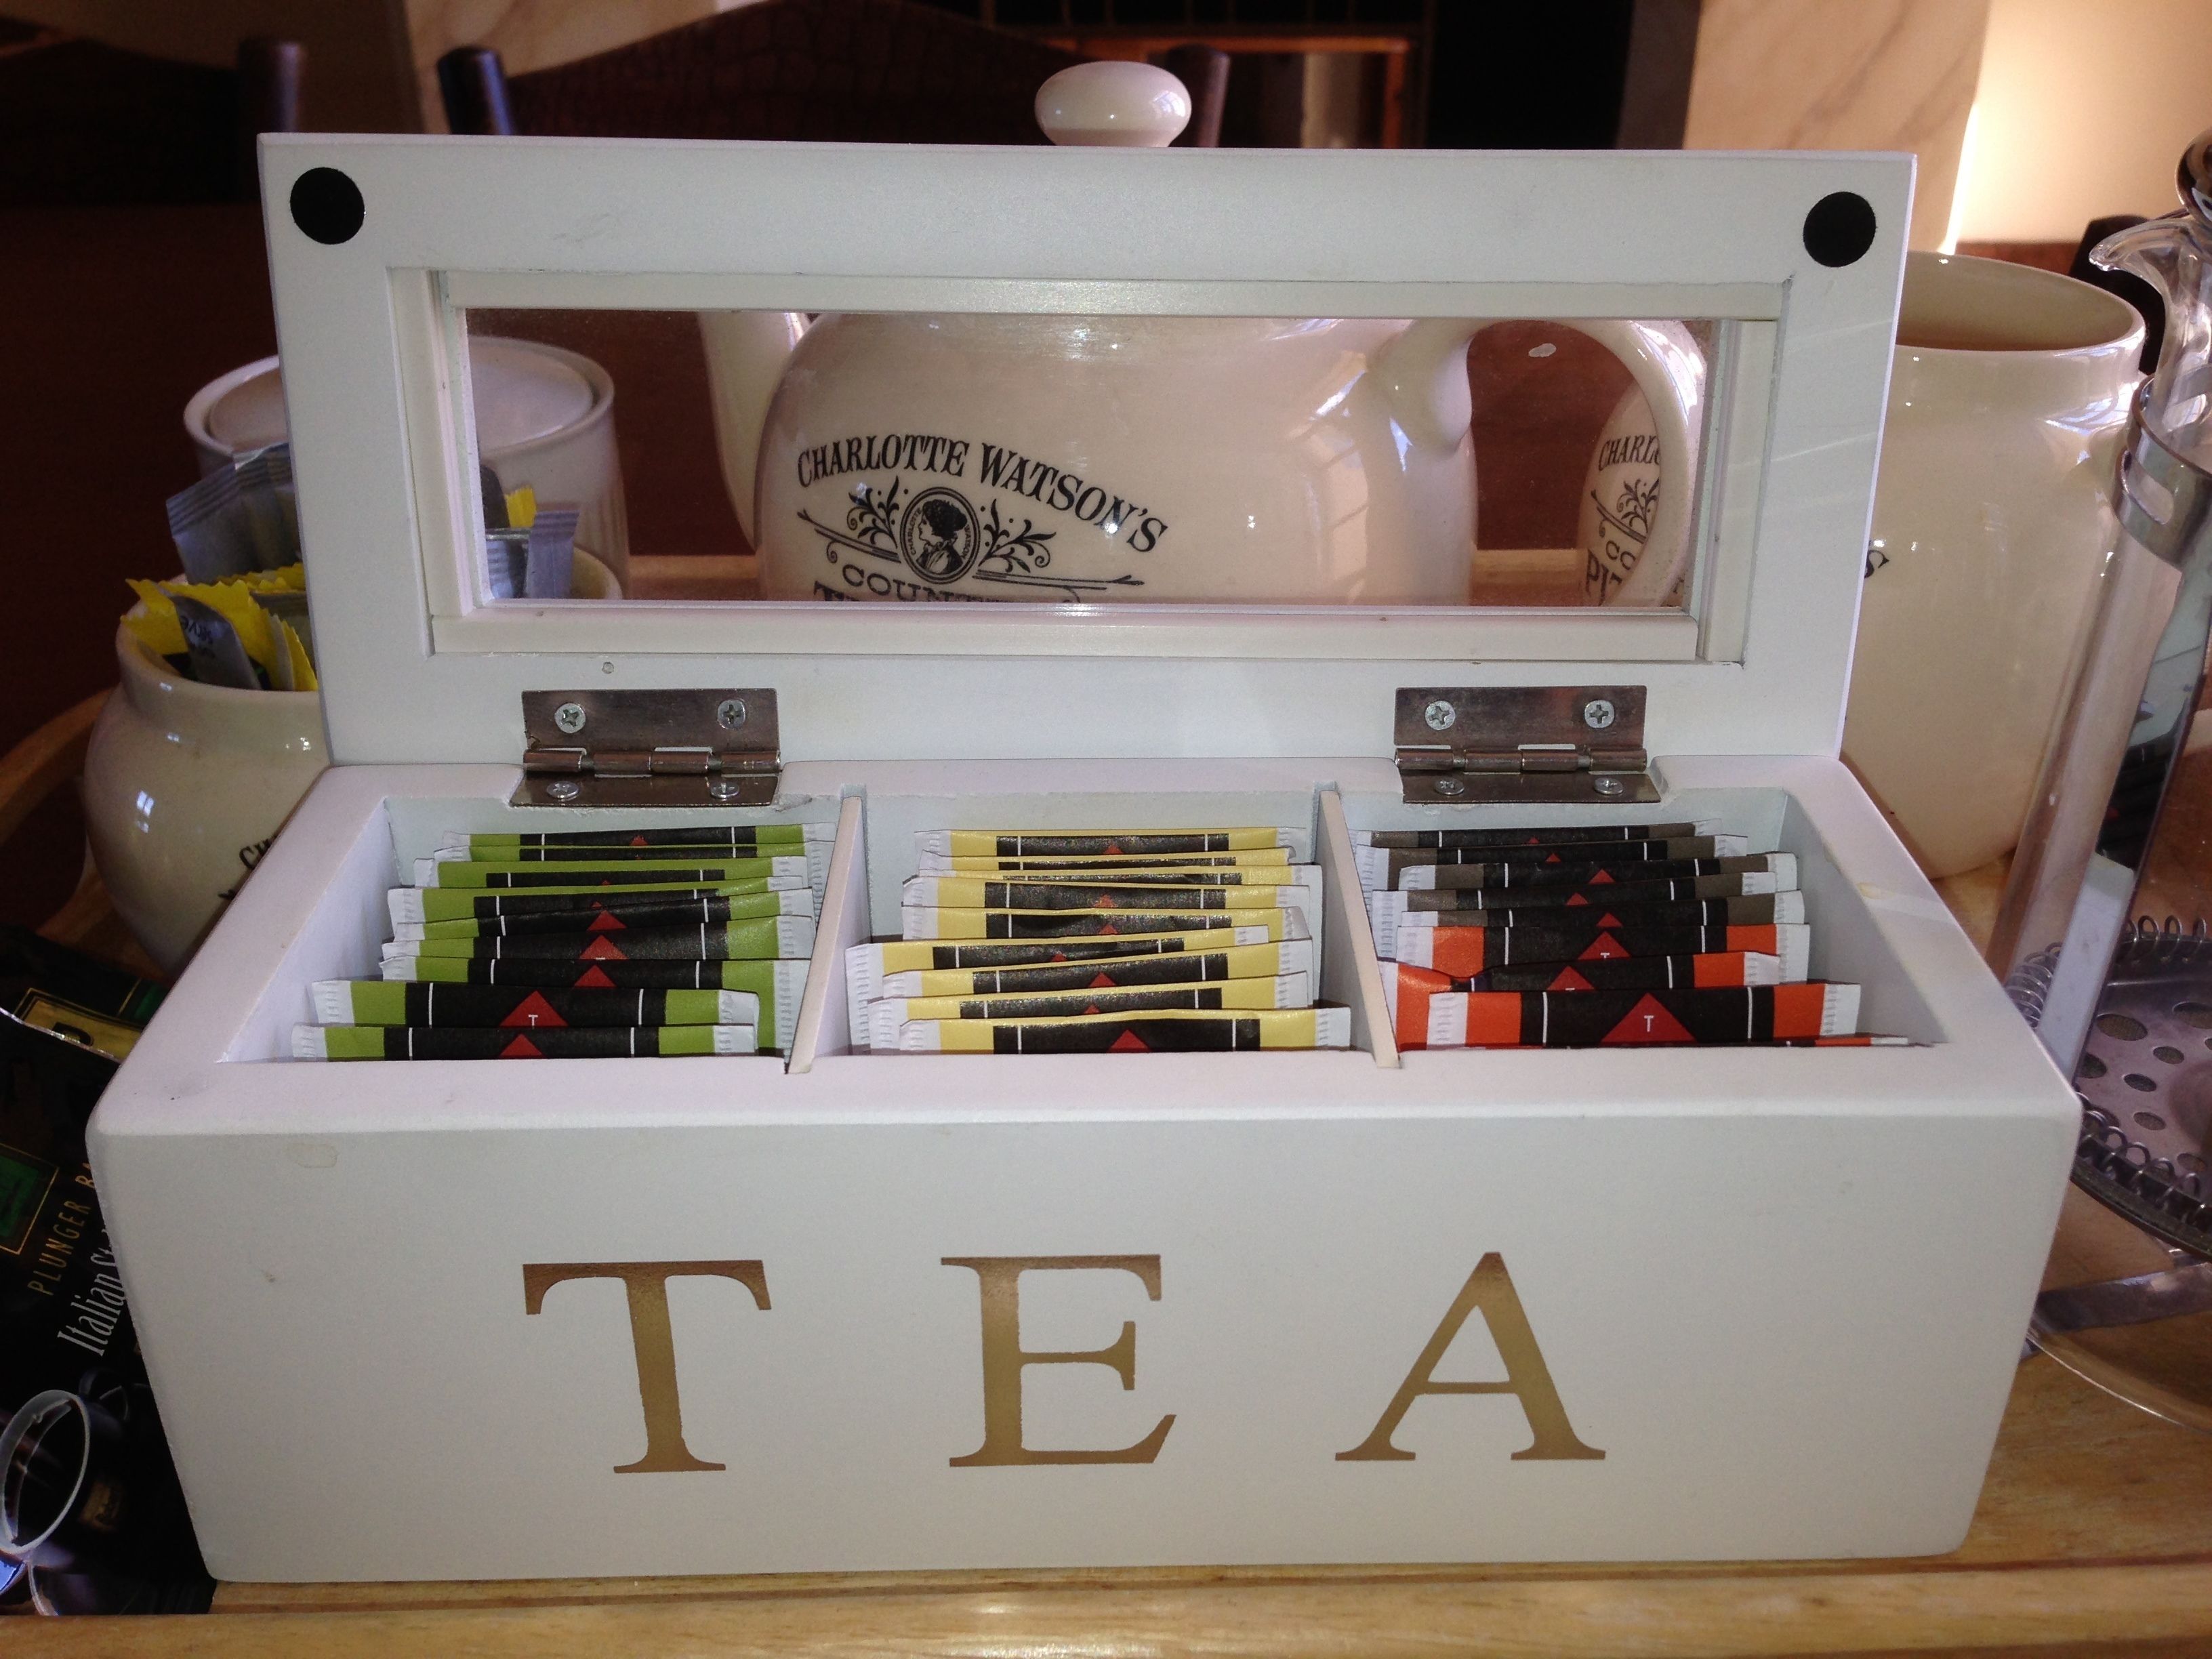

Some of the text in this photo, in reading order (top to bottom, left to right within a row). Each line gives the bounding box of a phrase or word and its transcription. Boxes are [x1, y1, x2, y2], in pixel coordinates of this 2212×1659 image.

[797, 434, 1168, 554] CHARLOTTE WATSON'S
[1598, 434, 1660, 472] CHARL
[1644, 1015, 1654, 1032] T
[28, 1200, 91, 1296] PLUNGER
[57, 1273, 126, 1357] Italian
